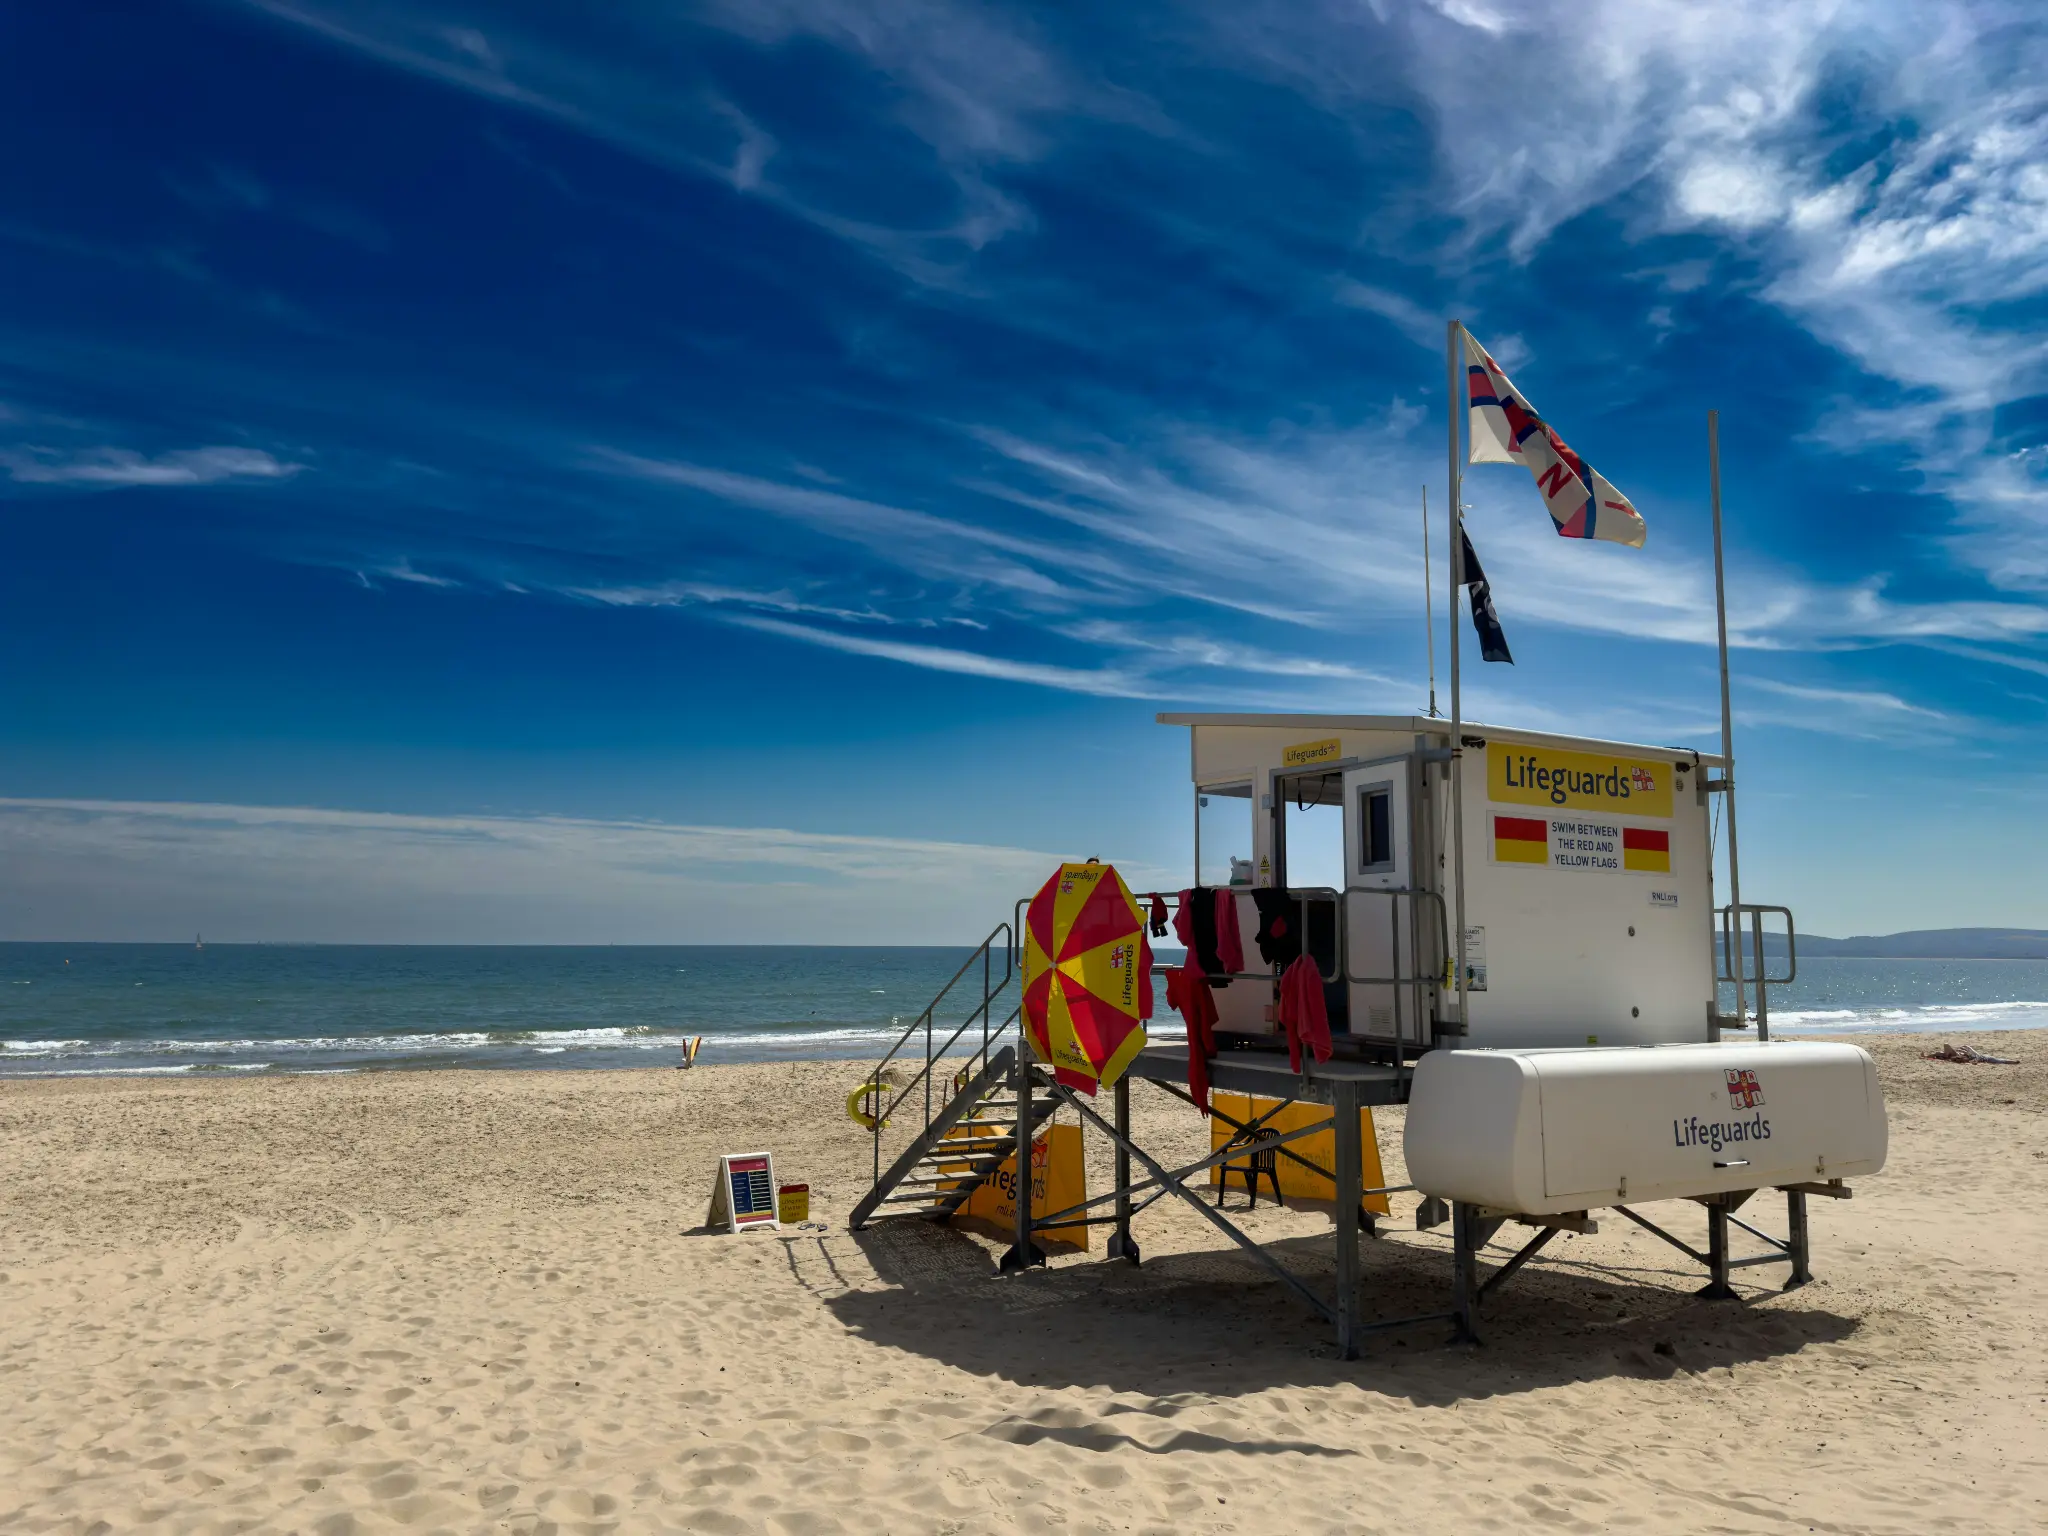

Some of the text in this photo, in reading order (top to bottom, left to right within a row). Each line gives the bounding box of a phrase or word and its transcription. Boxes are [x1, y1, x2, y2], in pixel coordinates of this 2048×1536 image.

[1286, 745, 1328, 763] Lifeguards
[1506, 755, 1631, 804] Lifeguards
[1551, 821, 1618, 838] SWIM BETWEEN
[1557, 838, 1614, 853] THE RED AND
[1554, 853, 1618, 869] YELLOW FLAGS
[1651, 891, 1678, 904] RNLI.org
[1122, 943, 1135, 1006] Lifeguards
[1674, 1111, 1771, 1153] Lifeguards
